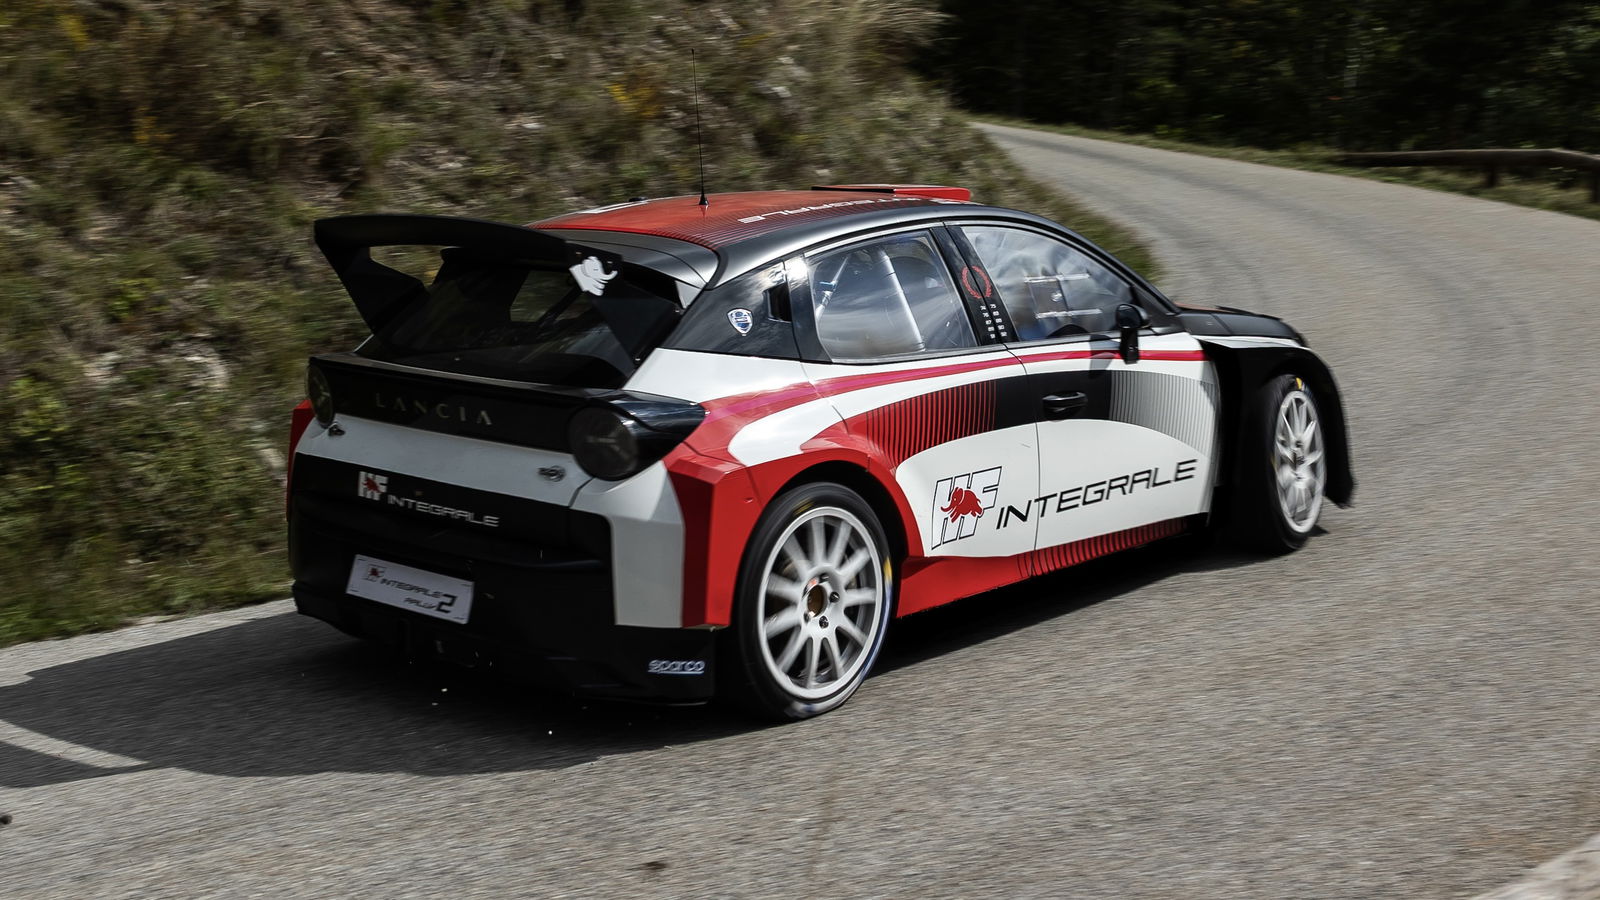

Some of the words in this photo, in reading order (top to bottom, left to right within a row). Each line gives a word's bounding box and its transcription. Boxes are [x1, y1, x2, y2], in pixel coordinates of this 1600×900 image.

[375, 392, 493, 426] LANCIA
[387, 494, 500, 527] INTEGRALE
[931, 466, 1002, 550] HF
[996, 458, 1198, 530] INTEGRALE
[434, 593, 458, 614] 2
[648, 659, 706, 675] sparco
